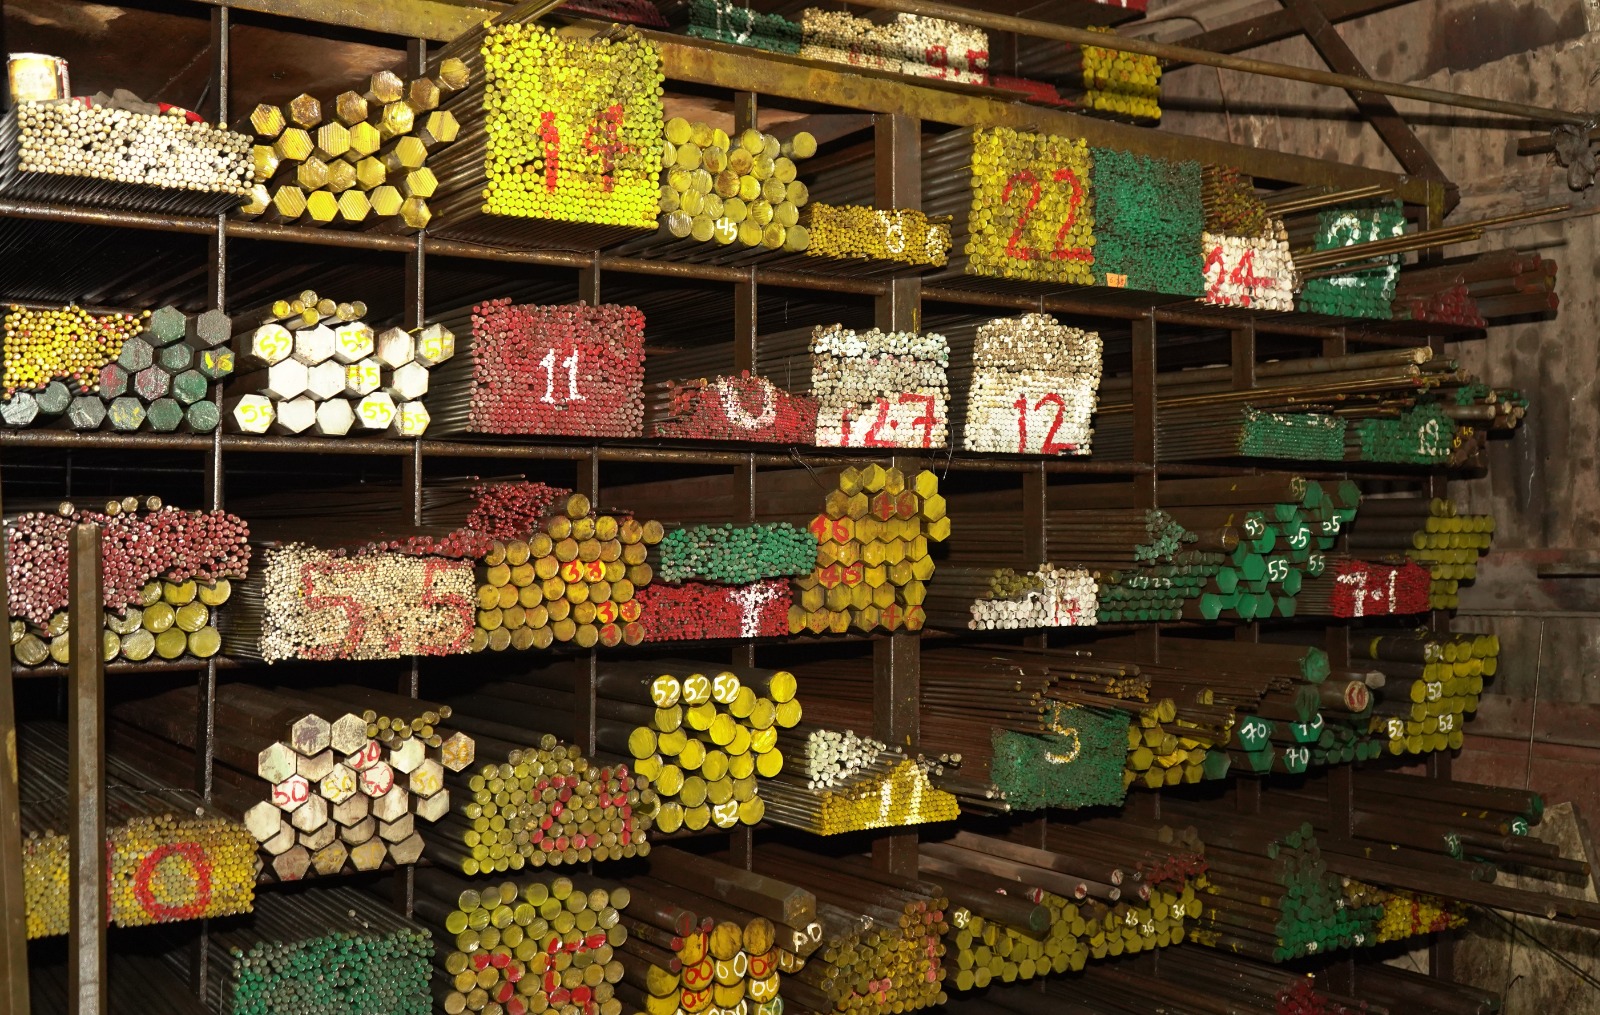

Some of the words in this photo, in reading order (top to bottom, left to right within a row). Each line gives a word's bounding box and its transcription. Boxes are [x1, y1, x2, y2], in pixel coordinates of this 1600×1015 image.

[541, 105, 640, 194] 14
[1002, 169, 1095, 261] 22
[716, 217, 738, 240] 45
[1203, 246, 1276, 307] 24
[259, 330, 290, 356] 55
[339, 330, 371, 353] 55
[348, 364, 379, 387] 55
[538, 349, 587, 404] 11
[240, 404, 273, 427] 55
[363, 402, 392, 423] 55
[402, 411, 427, 431] 55
[841, 392, 944, 448] 12.7
[1014, 392, 1079, 454] 12
[811, 514, 850, 543] 46
[1245, 519, 1265, 536] 55
[1268, 559, 1289, 581] 55
[1308, 554, 1326, 572] 55
[652, 680, 679, 704] 52
[682, 677, 711, 704] 52
[713, 675, 741, 703] 52
[1427, 681, 1442, 700] 52
[1241, 722, 1267, 744] 70
[1388, 719, 1404, 739] 52
[1438, 714, 1454, 732] 52
[1286, 746, 1309, 767] 70
[413, 771, 438, 792] 50
[273, 780, 309, 807] 50
[714, 799, 739, 827] 52
[685, 960, 713, 985] 60
[716, 951, 748, 979] 60
